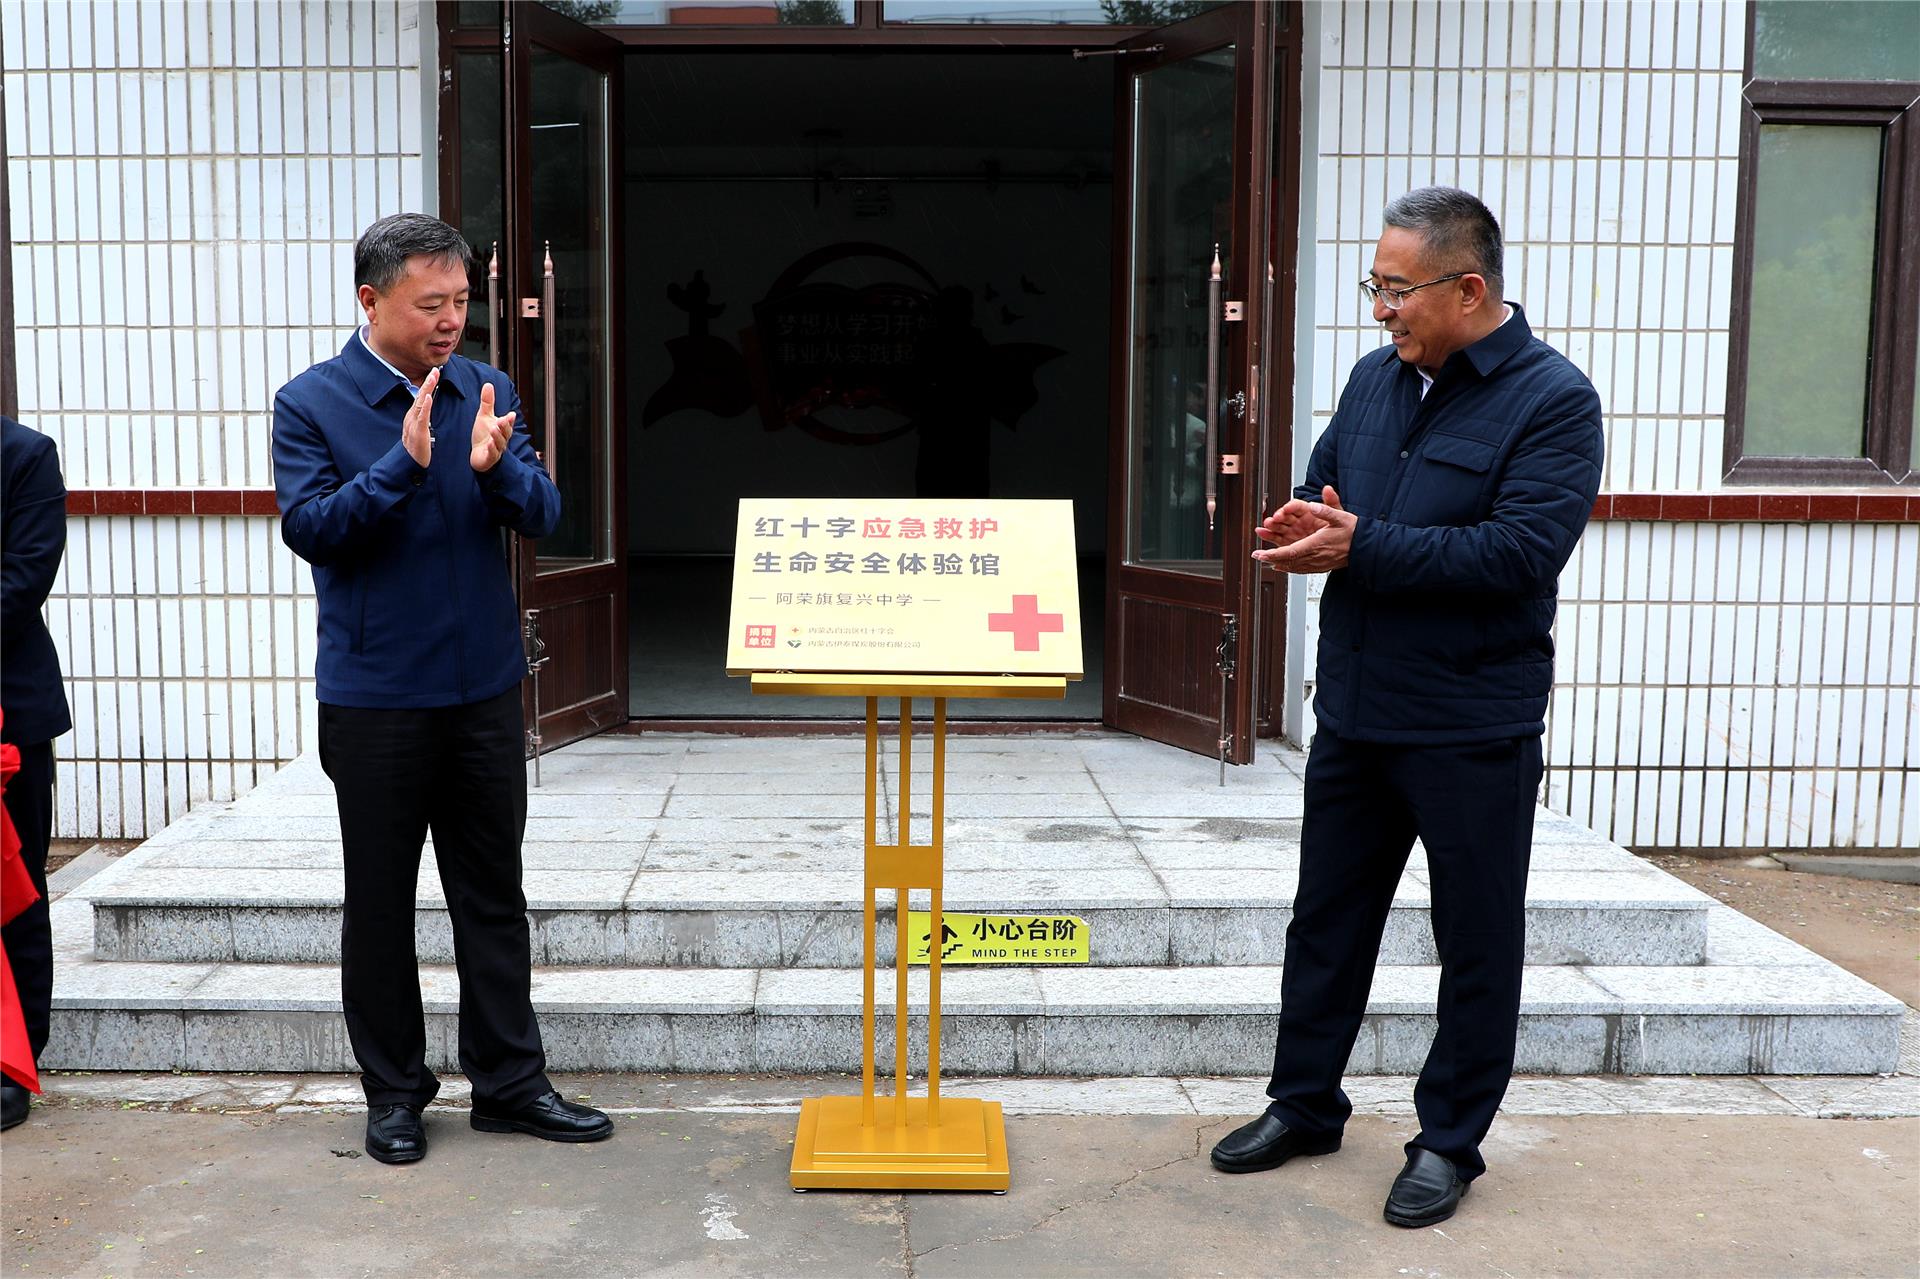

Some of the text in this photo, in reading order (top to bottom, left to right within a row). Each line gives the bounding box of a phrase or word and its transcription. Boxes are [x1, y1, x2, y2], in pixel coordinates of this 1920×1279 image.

[754, 516, 999, 539] 红十字应急救护
[753, 552, 1000, 576] 生命安全体验馆
[972, 918, 1077, 941] 小心台阶
[972, 949, 1077, 958] MIND THE STEP
